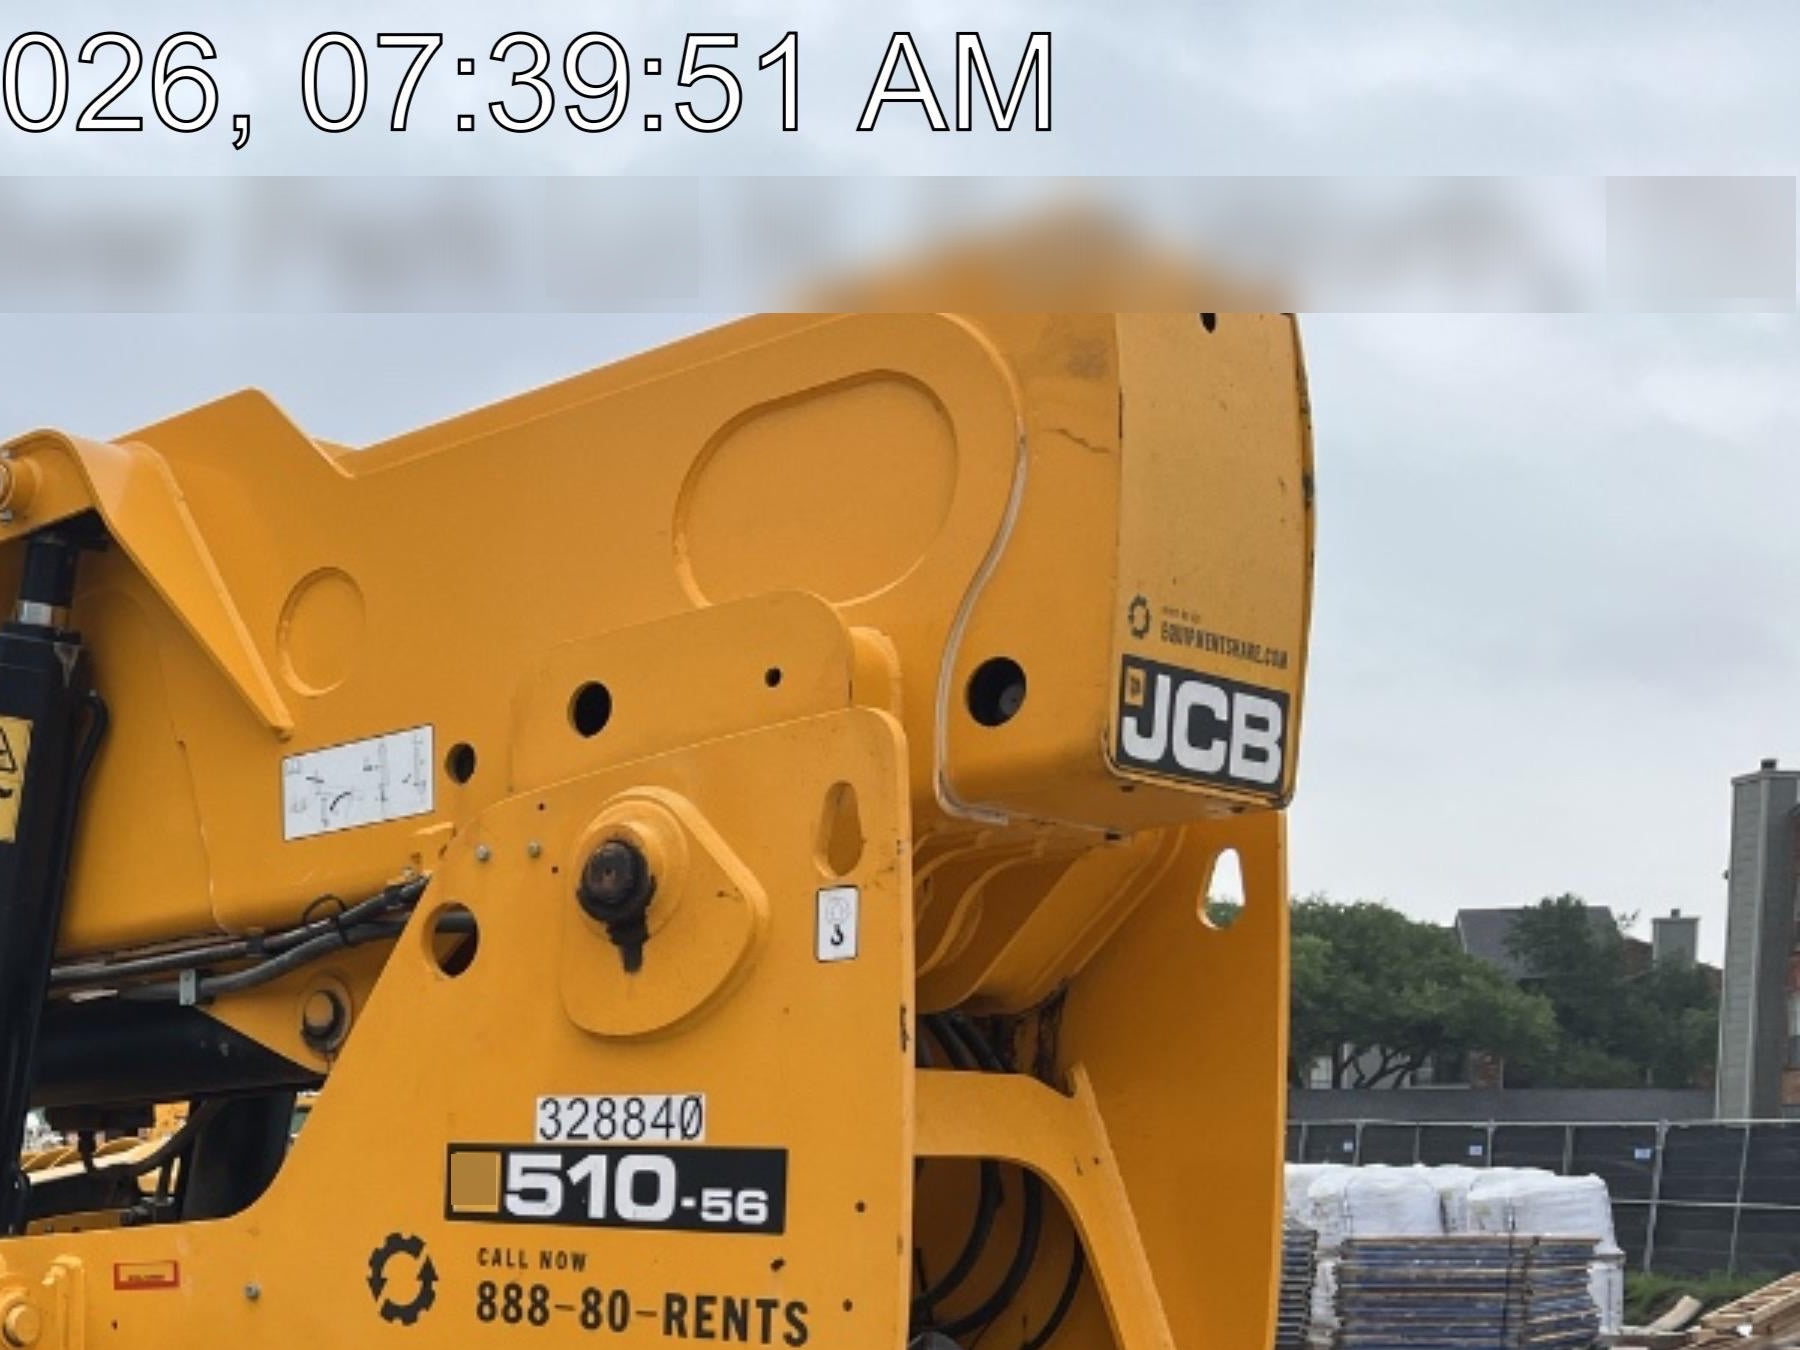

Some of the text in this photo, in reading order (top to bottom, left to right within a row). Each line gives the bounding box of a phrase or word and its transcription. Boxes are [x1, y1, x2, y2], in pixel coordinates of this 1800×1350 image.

[1121, 672, 1283, 784] JCB
[538, 1096, 703, 1142] 328840
[477, 1247, 588, 1273] CALL NOW
[475, 1280, 810, 1347] 888-80-RENTS
